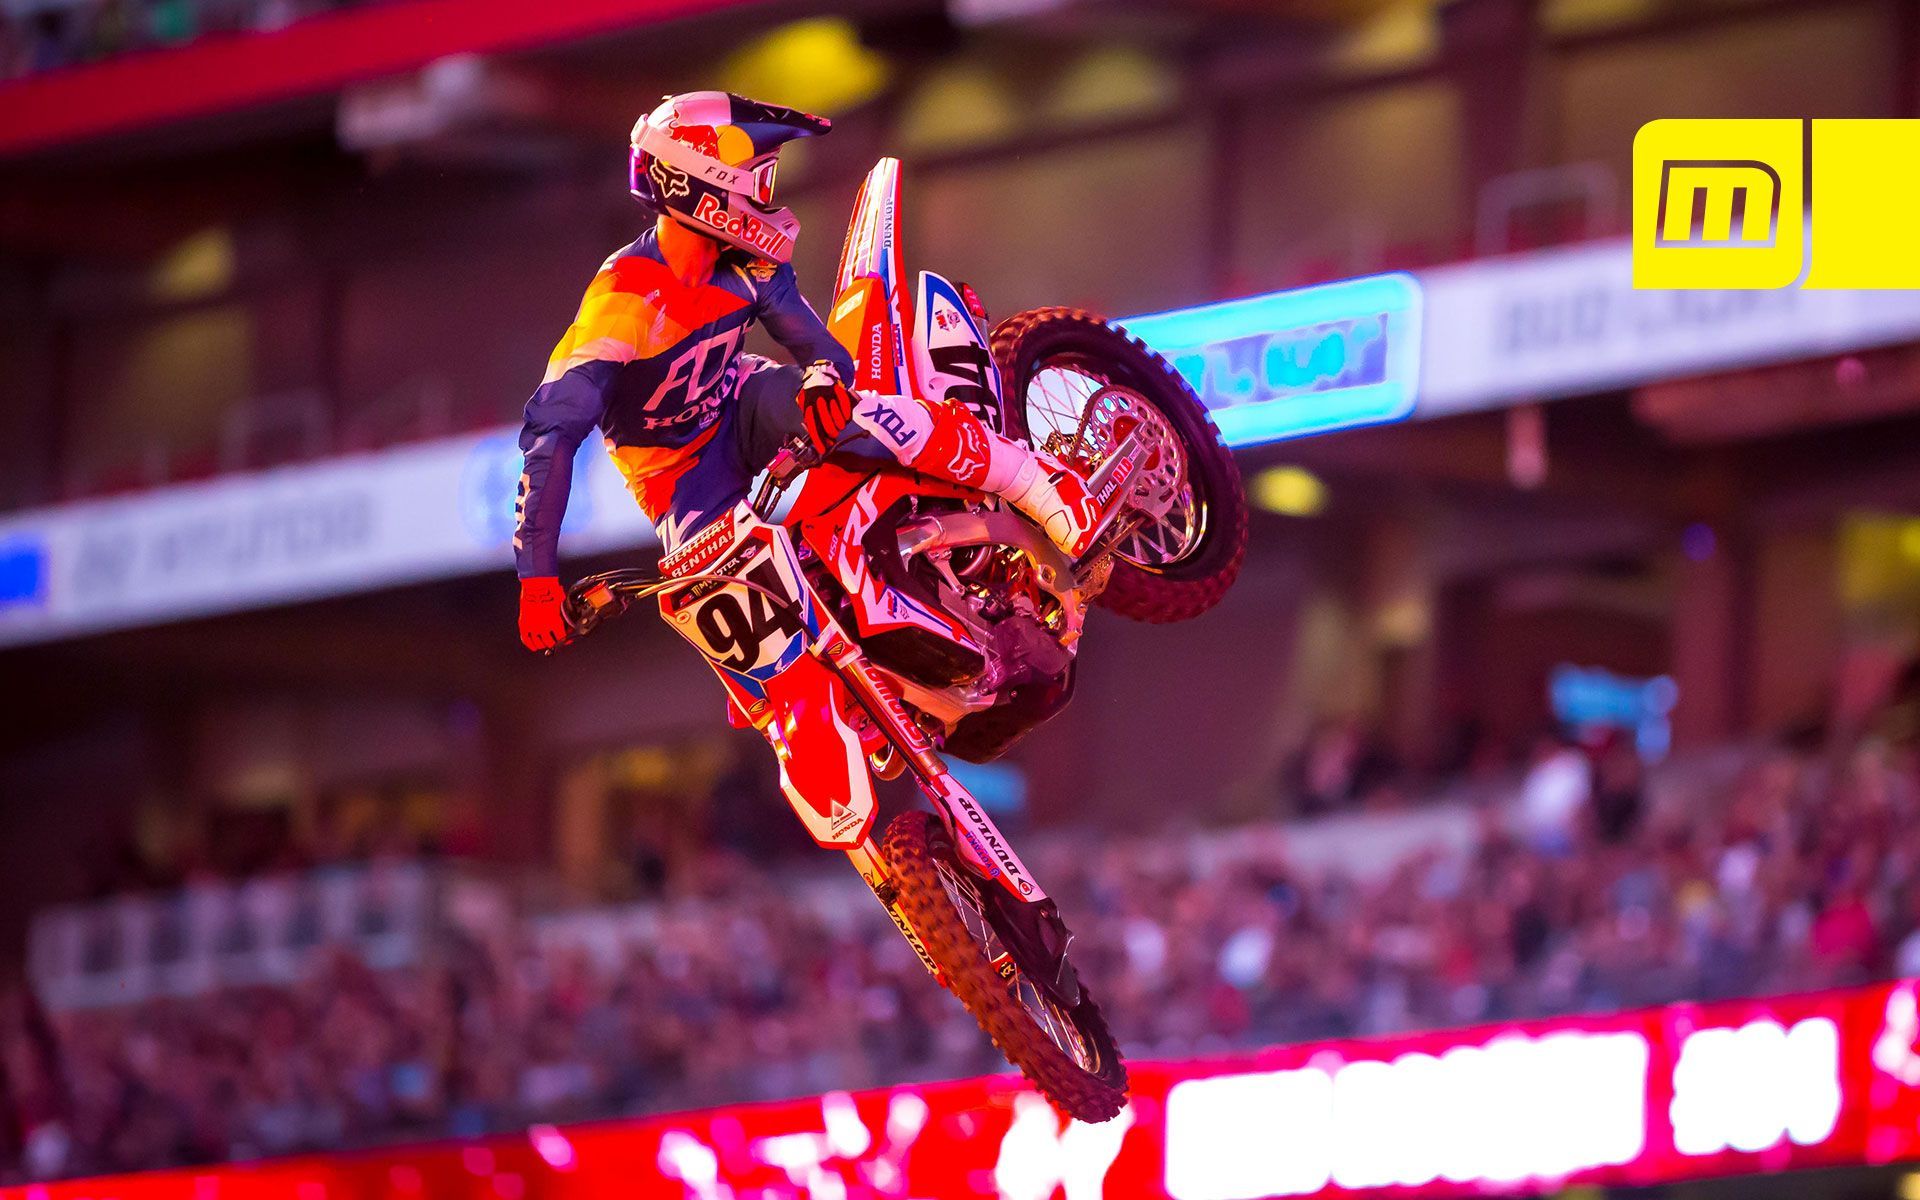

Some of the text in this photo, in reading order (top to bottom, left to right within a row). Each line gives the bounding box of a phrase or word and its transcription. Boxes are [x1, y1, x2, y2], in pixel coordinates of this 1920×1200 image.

[705, 166, 739, 185] FOX
[884, 198, 893, 248] DUNLOP
[642, 316, 753, 412] FO
[871, 322, 883, 380] HONDA
[861, 403, 917, 447] FOX
[663, 518, 729, 570] RENTHAL
[671, 530, 735, 578] RENTHAL
[696, 556, 804, 674] 94
[831, 817, 864, 840] HONDA
[958, 797, 1021, 876] DUNLOP
[886, 905, 937, 971] UNLOP
